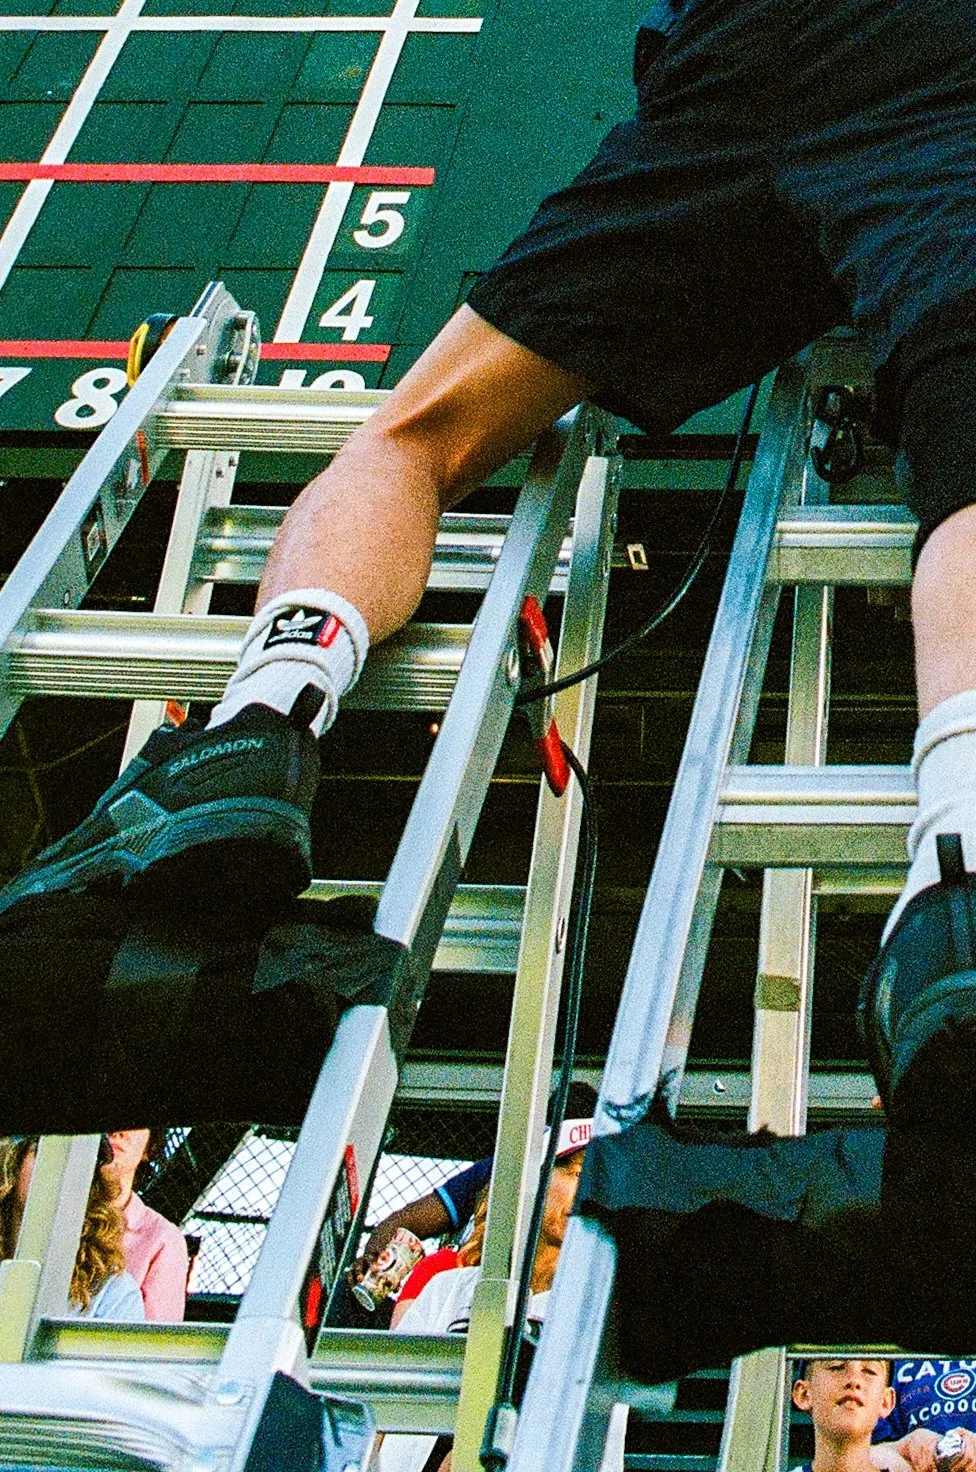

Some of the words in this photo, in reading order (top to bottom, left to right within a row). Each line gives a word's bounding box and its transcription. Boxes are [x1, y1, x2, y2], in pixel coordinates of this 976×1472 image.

[353, 191, 410, 248] 5
[320, 280, 375, 341] 4
[54, 367, 128, 429] 8
[168, 738, 265, 777] SALOMON
